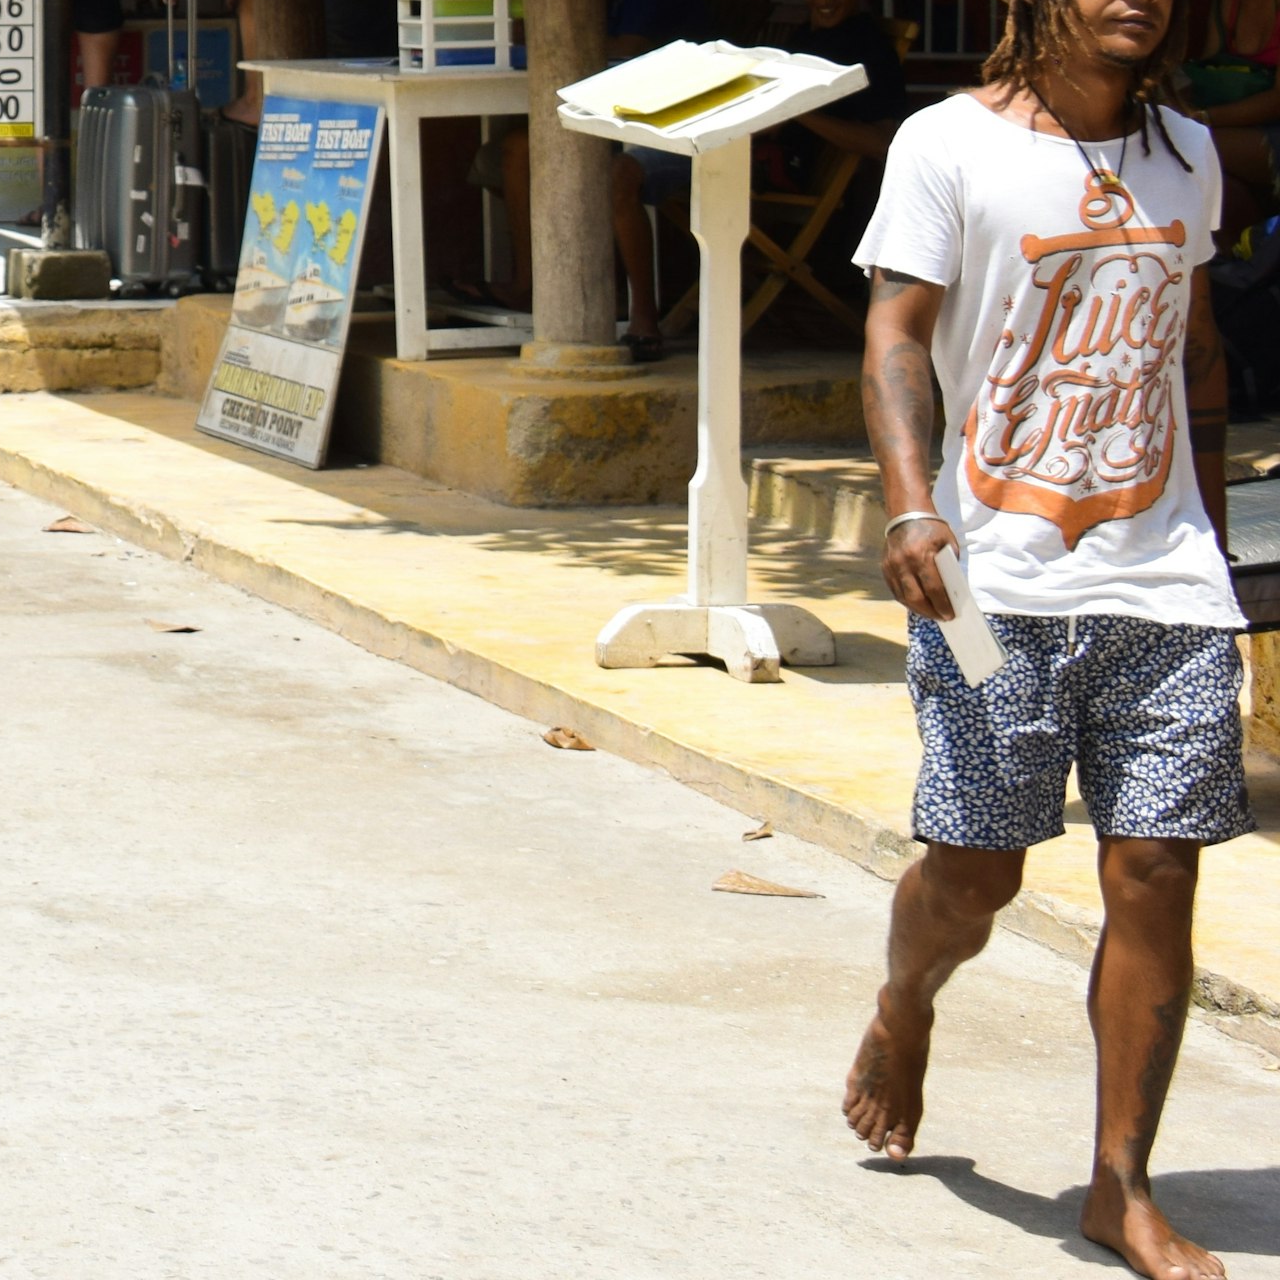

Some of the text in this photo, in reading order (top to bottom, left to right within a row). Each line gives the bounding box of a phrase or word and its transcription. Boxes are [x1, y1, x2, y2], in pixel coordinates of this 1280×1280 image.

[260, 122, 313, 142] FAST BOAT
[315, 129, 372, 149] FAST BOAT
[269, 412, 303, 439] POINT
